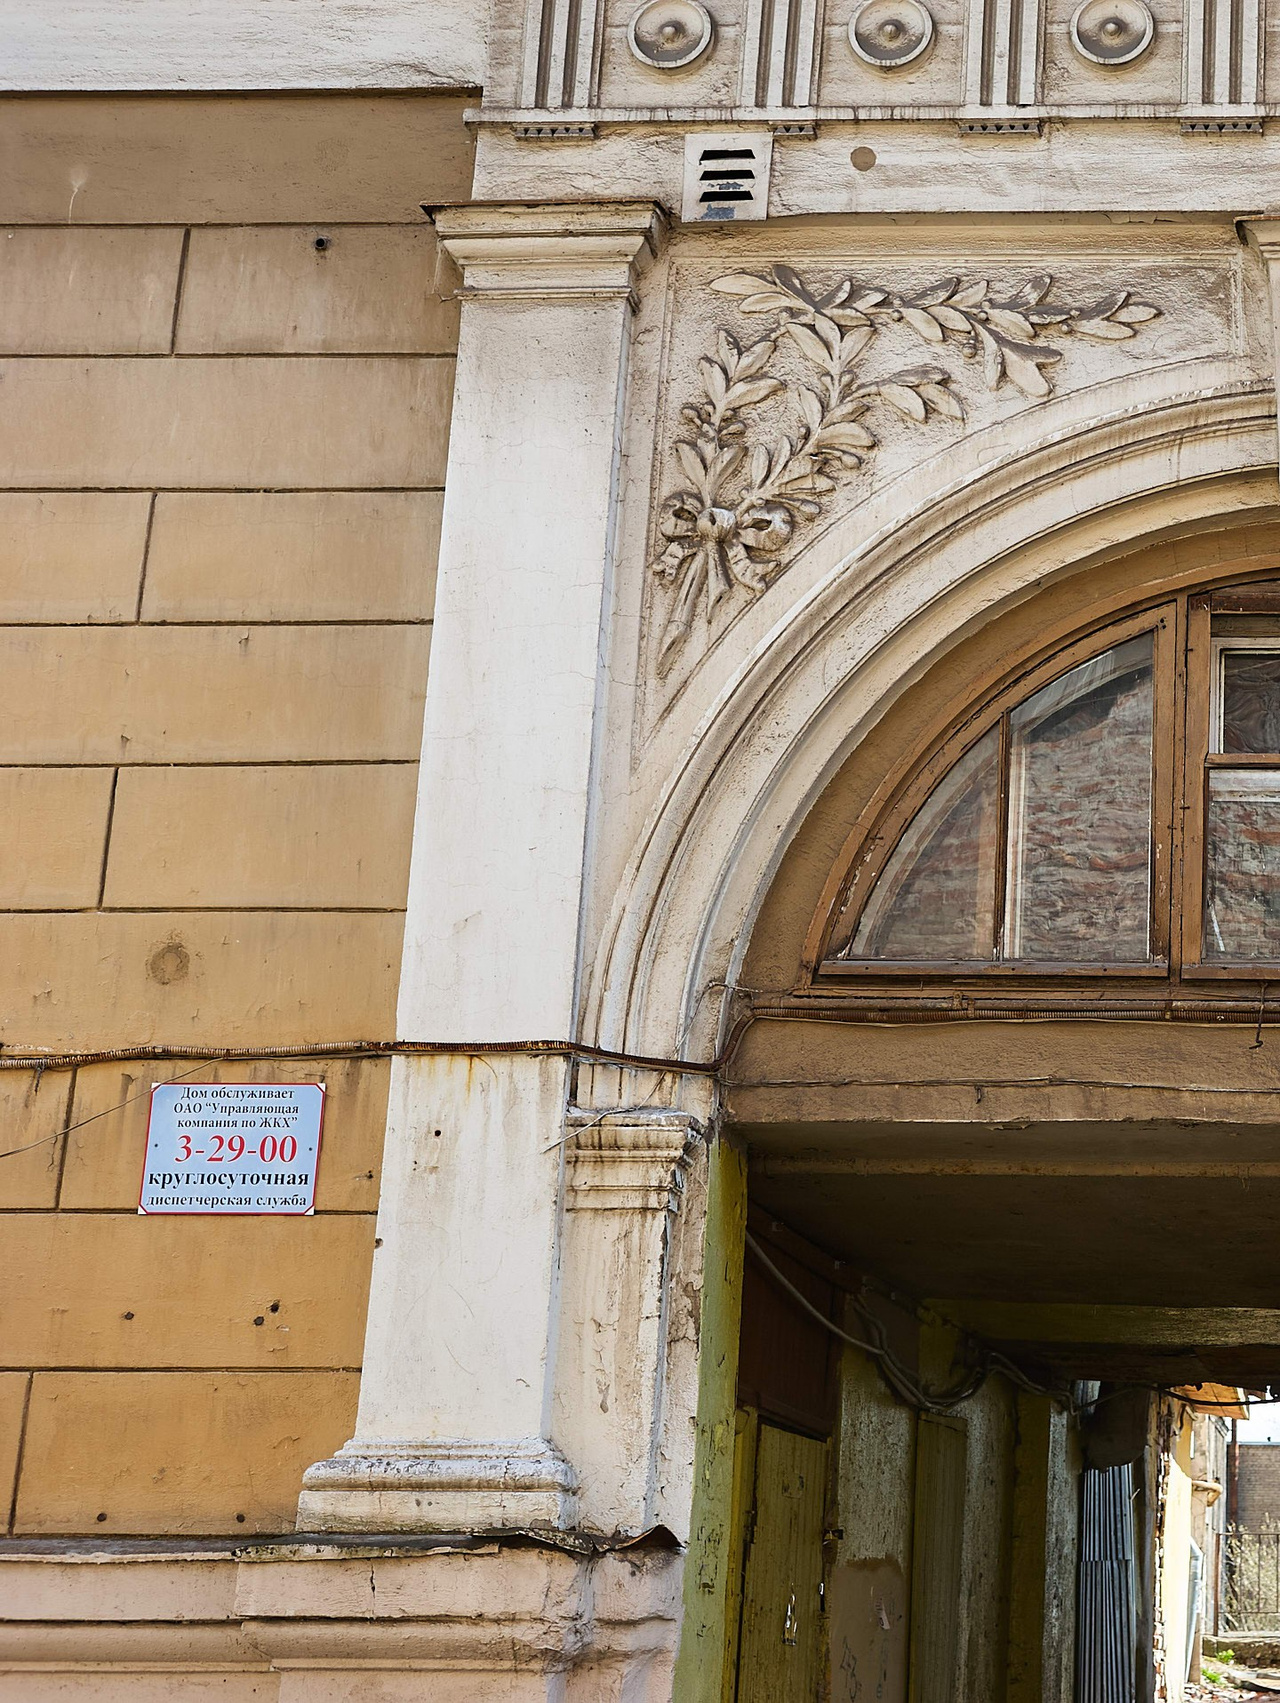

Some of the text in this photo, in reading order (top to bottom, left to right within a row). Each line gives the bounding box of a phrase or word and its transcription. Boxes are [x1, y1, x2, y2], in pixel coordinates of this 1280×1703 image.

[181, 1087, 295, 1101] Дом обслуживает
[174, 1103, 202, 1114] ОАО
[177, 1119, 238, 1128] компания
[241, 1119, 256, 1128] по
[174, 1135, 298, 1163] 3-29-00
[148, 1172, 309, 1189] круглосуточная
[146, 1194, 307, 1208] диспетчерская служба
